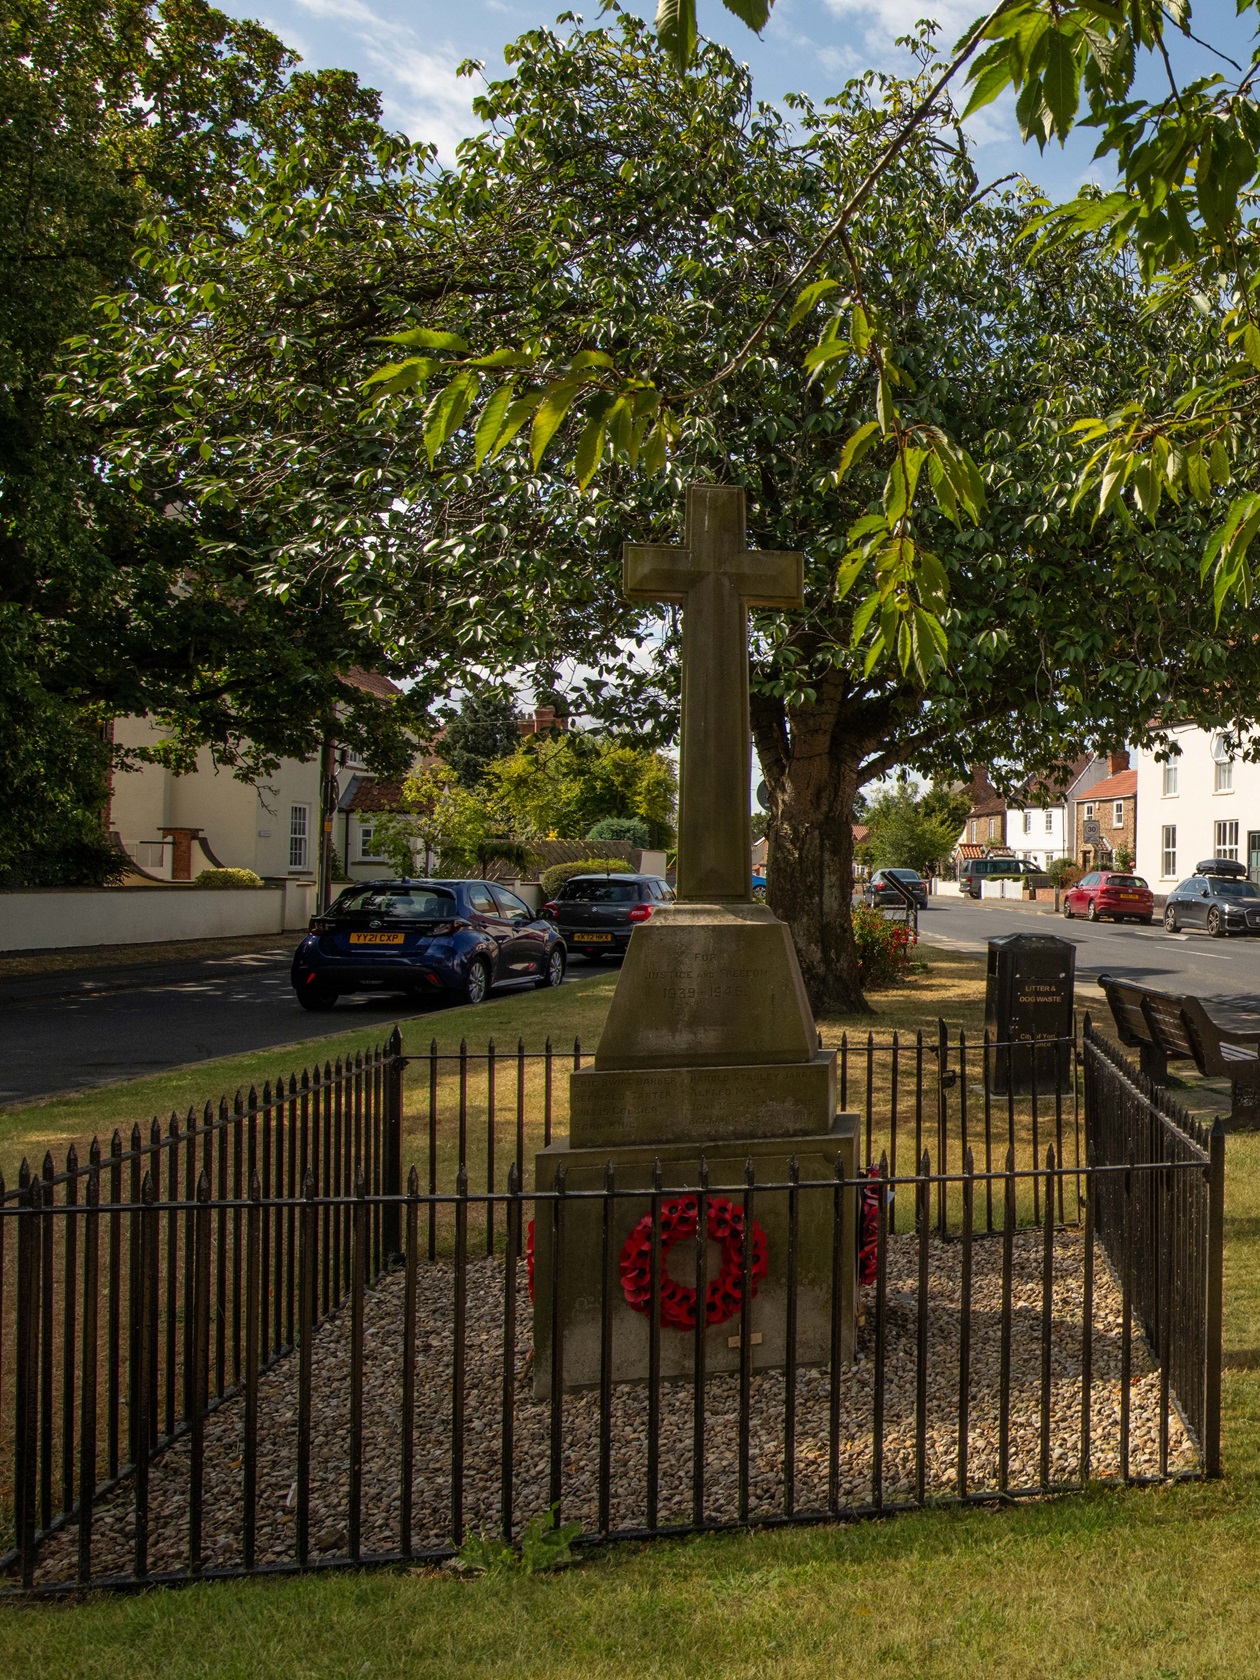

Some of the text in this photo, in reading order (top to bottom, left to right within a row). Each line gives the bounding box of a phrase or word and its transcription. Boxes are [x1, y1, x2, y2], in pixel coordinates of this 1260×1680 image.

[356, 933, 399, 942] YY21 CXP
[694, 952, 718, 962] FOR
[645, 968, 768, 980] JUSTICE AND FREEDOM
[573, 1080, 598, 1089] ERIC
[636, 1076, 677, 1086] BARBER
[690, 1073, 730, 1083] HAROLD
[733, 1072, 780, 1082] STANLEY
[690, 1088, 731, 1097] ALFRED
